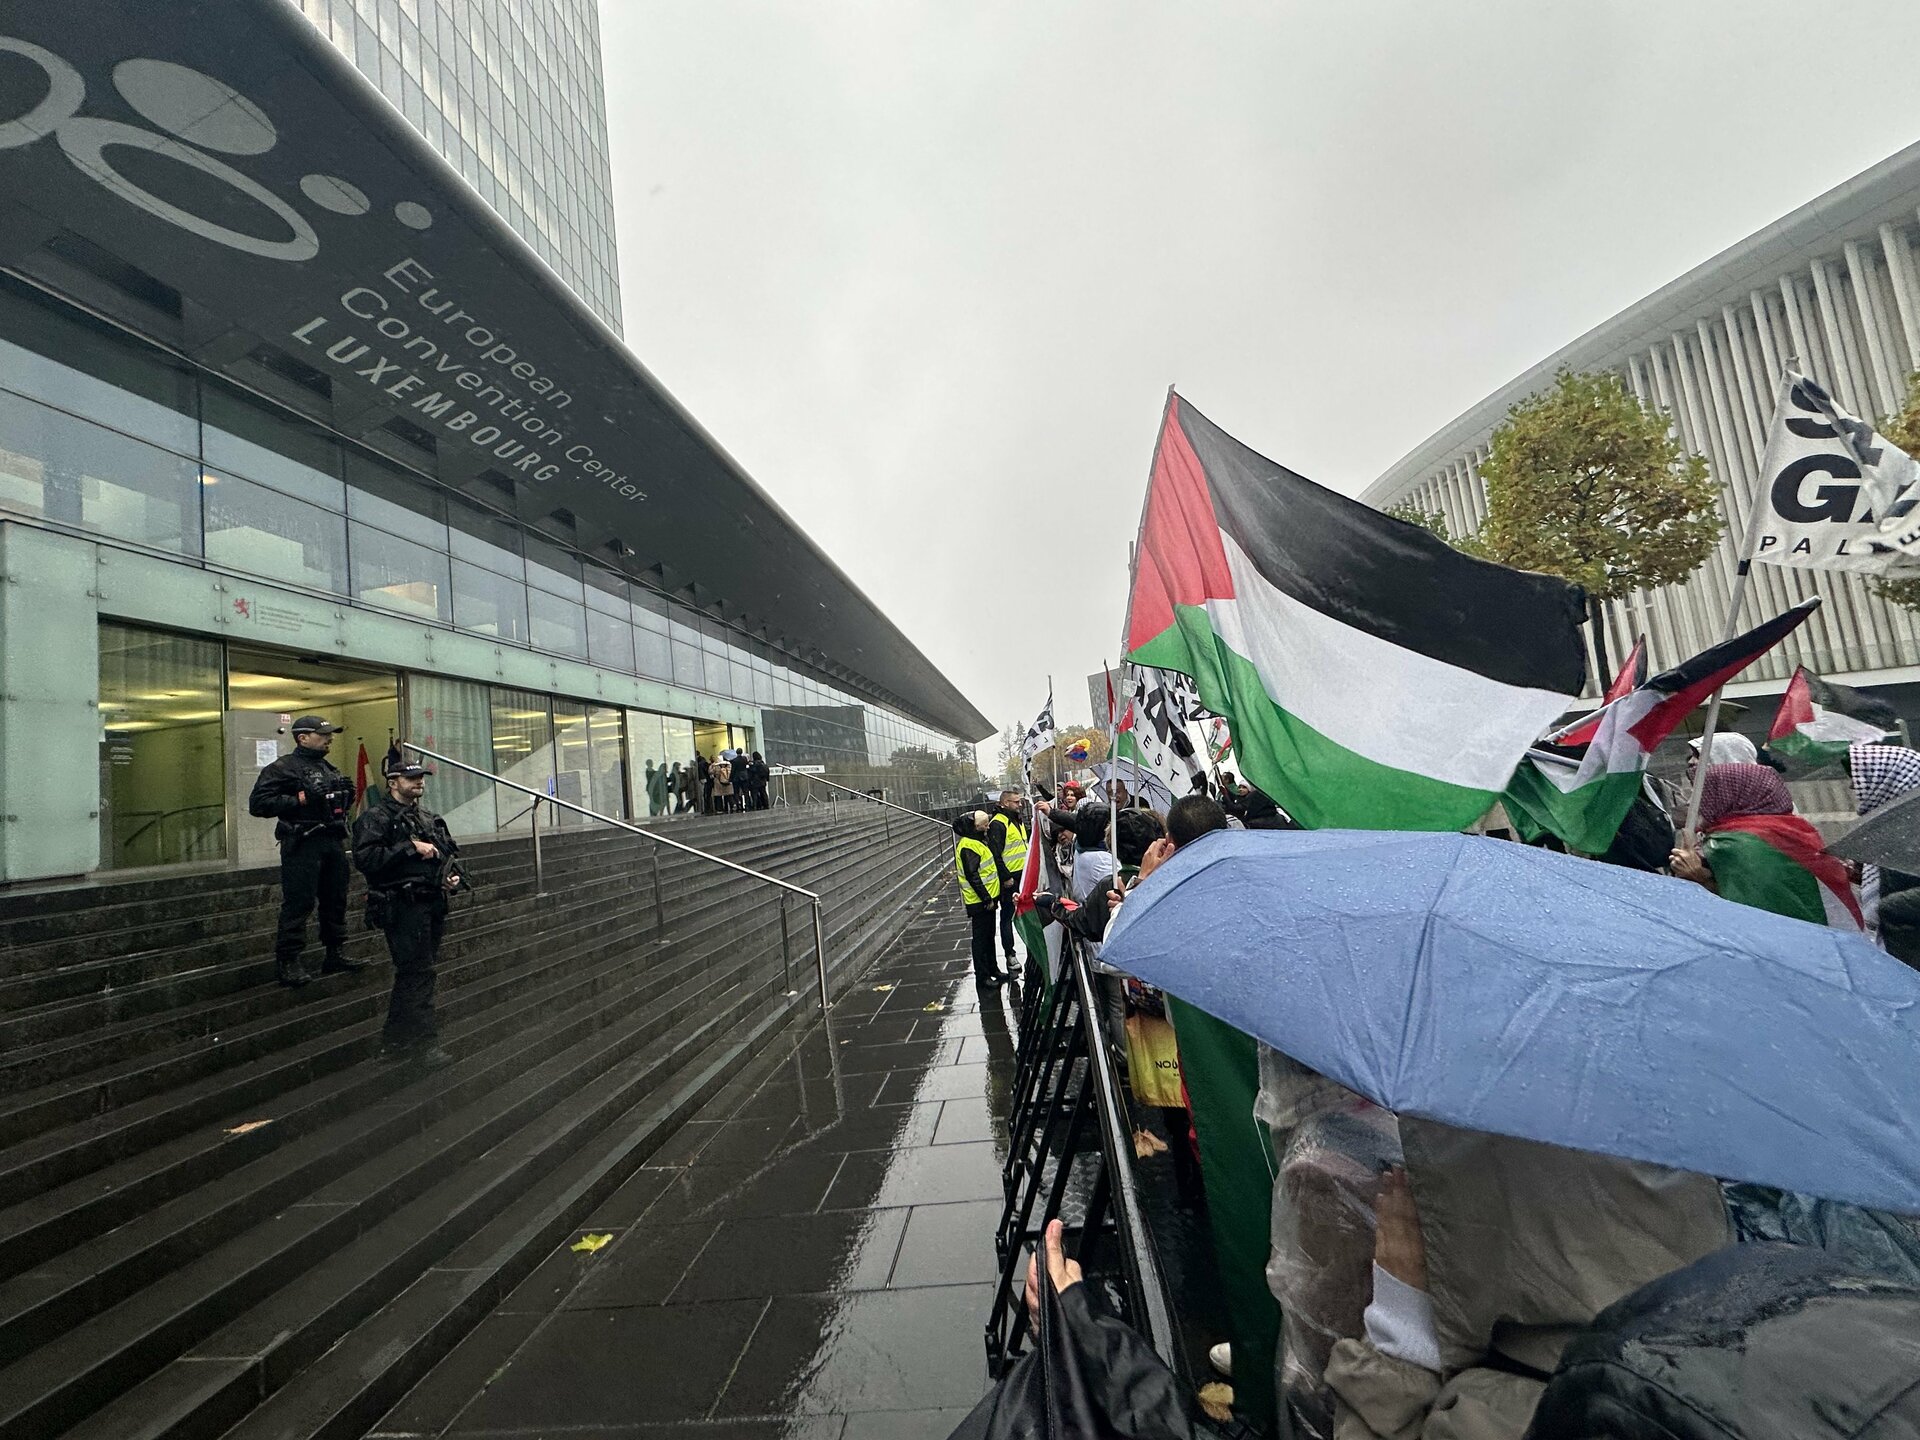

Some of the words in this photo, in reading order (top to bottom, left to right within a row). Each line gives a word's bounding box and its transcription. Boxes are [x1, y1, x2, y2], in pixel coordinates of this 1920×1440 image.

[292, 317, 561, 481] LUXEMBOURG
[341, 287, 563, 446] Convention
[565, 445, 648, 501] Center
[384, 258, 572, 410] European
